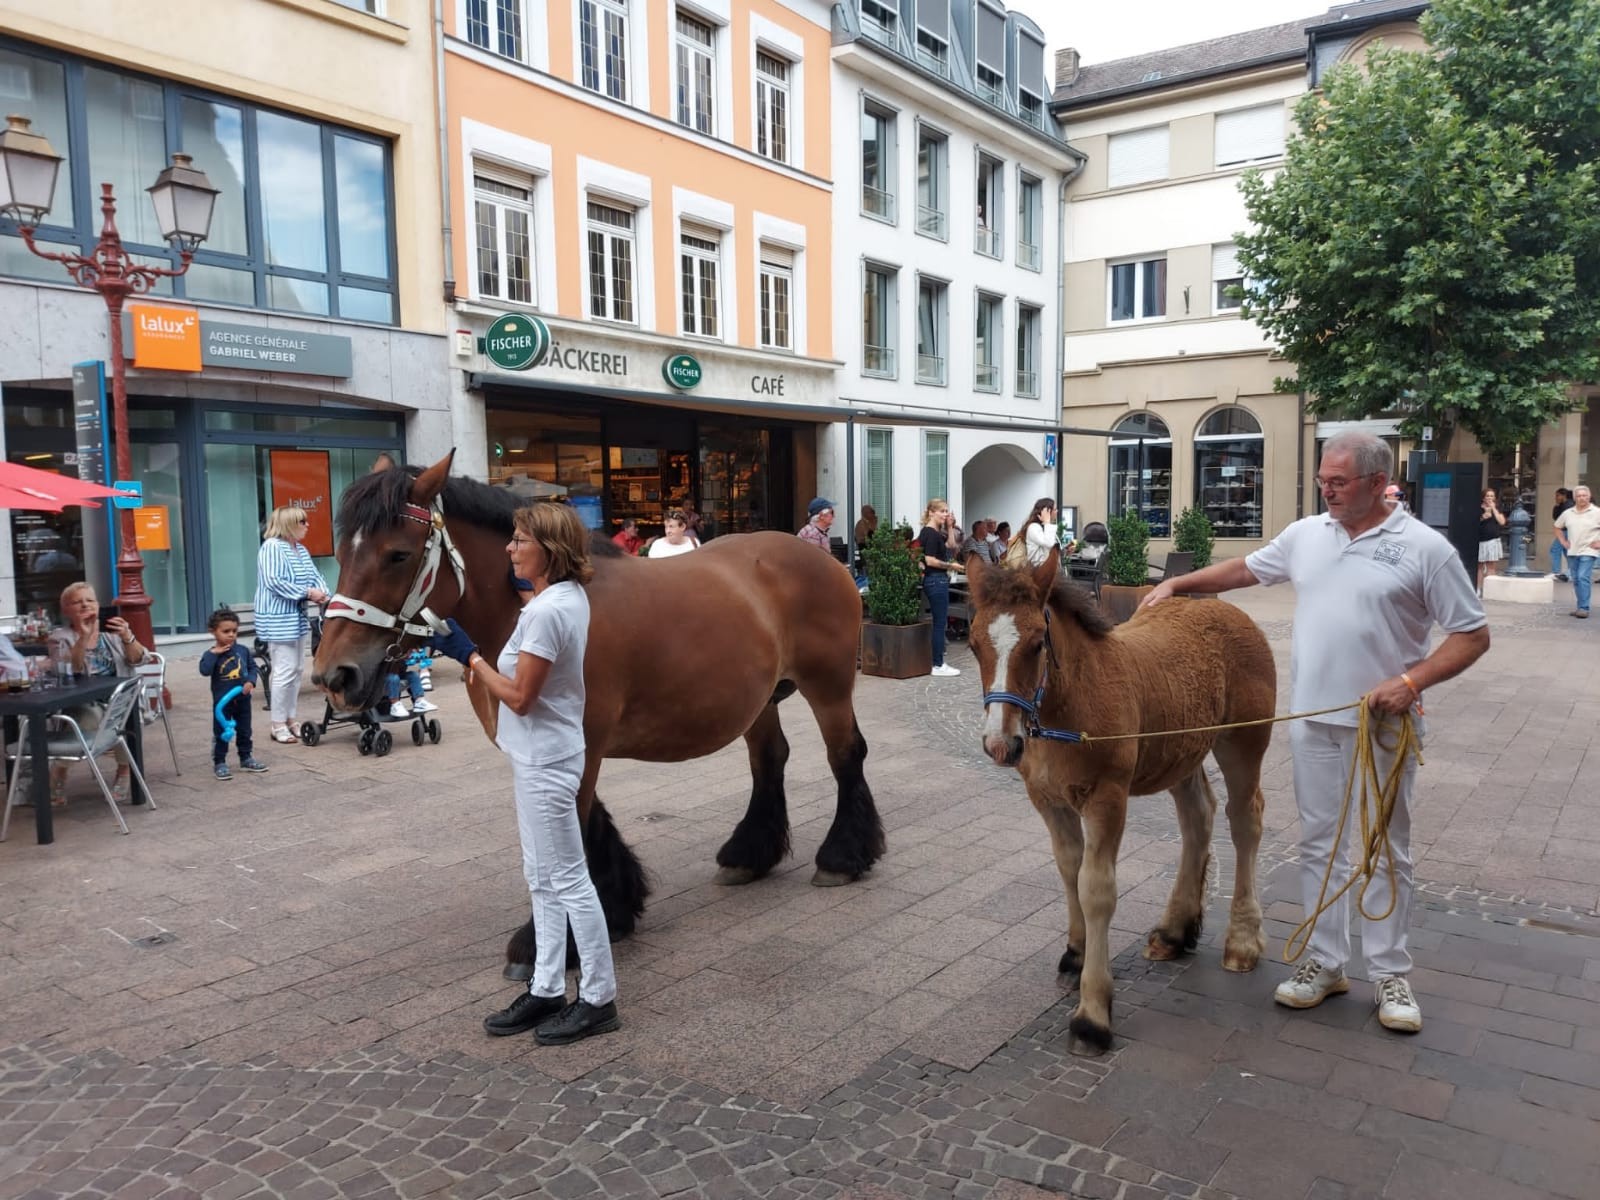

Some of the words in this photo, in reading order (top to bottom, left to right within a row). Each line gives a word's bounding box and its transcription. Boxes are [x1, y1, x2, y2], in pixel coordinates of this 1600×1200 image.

[141, 314, 185, 334] lalux
[209, 331, 253, 345] AGENCE
[254, 334, 308, 350] GÉNÉRALE
[491, 335, 532, 351] FISCHER
[209, 345, 258, 359] GABRIEL
[258, 349, 297, 363] WEBER
[673, 367, 699, 378] FISCHER
[751, 374, 785, 397] CAFÉ
[289, 497, 316, 508] lalux
